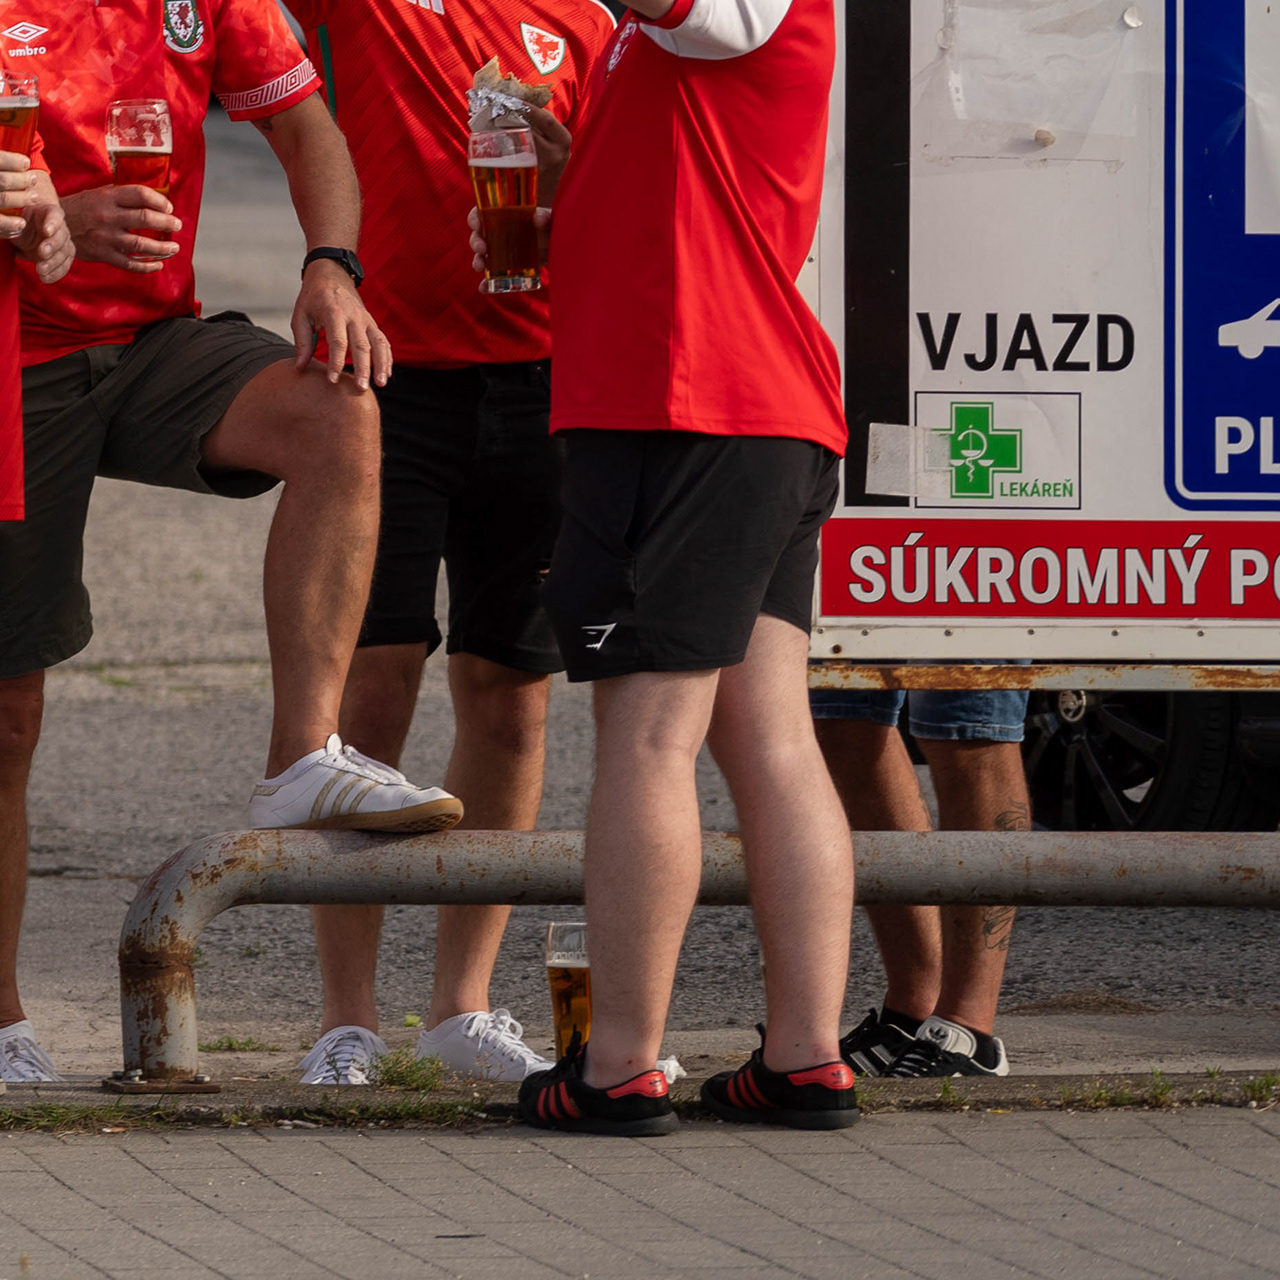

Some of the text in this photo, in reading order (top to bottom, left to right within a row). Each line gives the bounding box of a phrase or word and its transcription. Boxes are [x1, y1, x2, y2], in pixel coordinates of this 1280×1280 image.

[8, 45, 47, 57] umbro
[916, 312, 1135, 372] VJAZD
[999, 477, 1074, 498] LEKÁREŇ
[848, 531, 1280, 605] SÚKROMNÝ P
